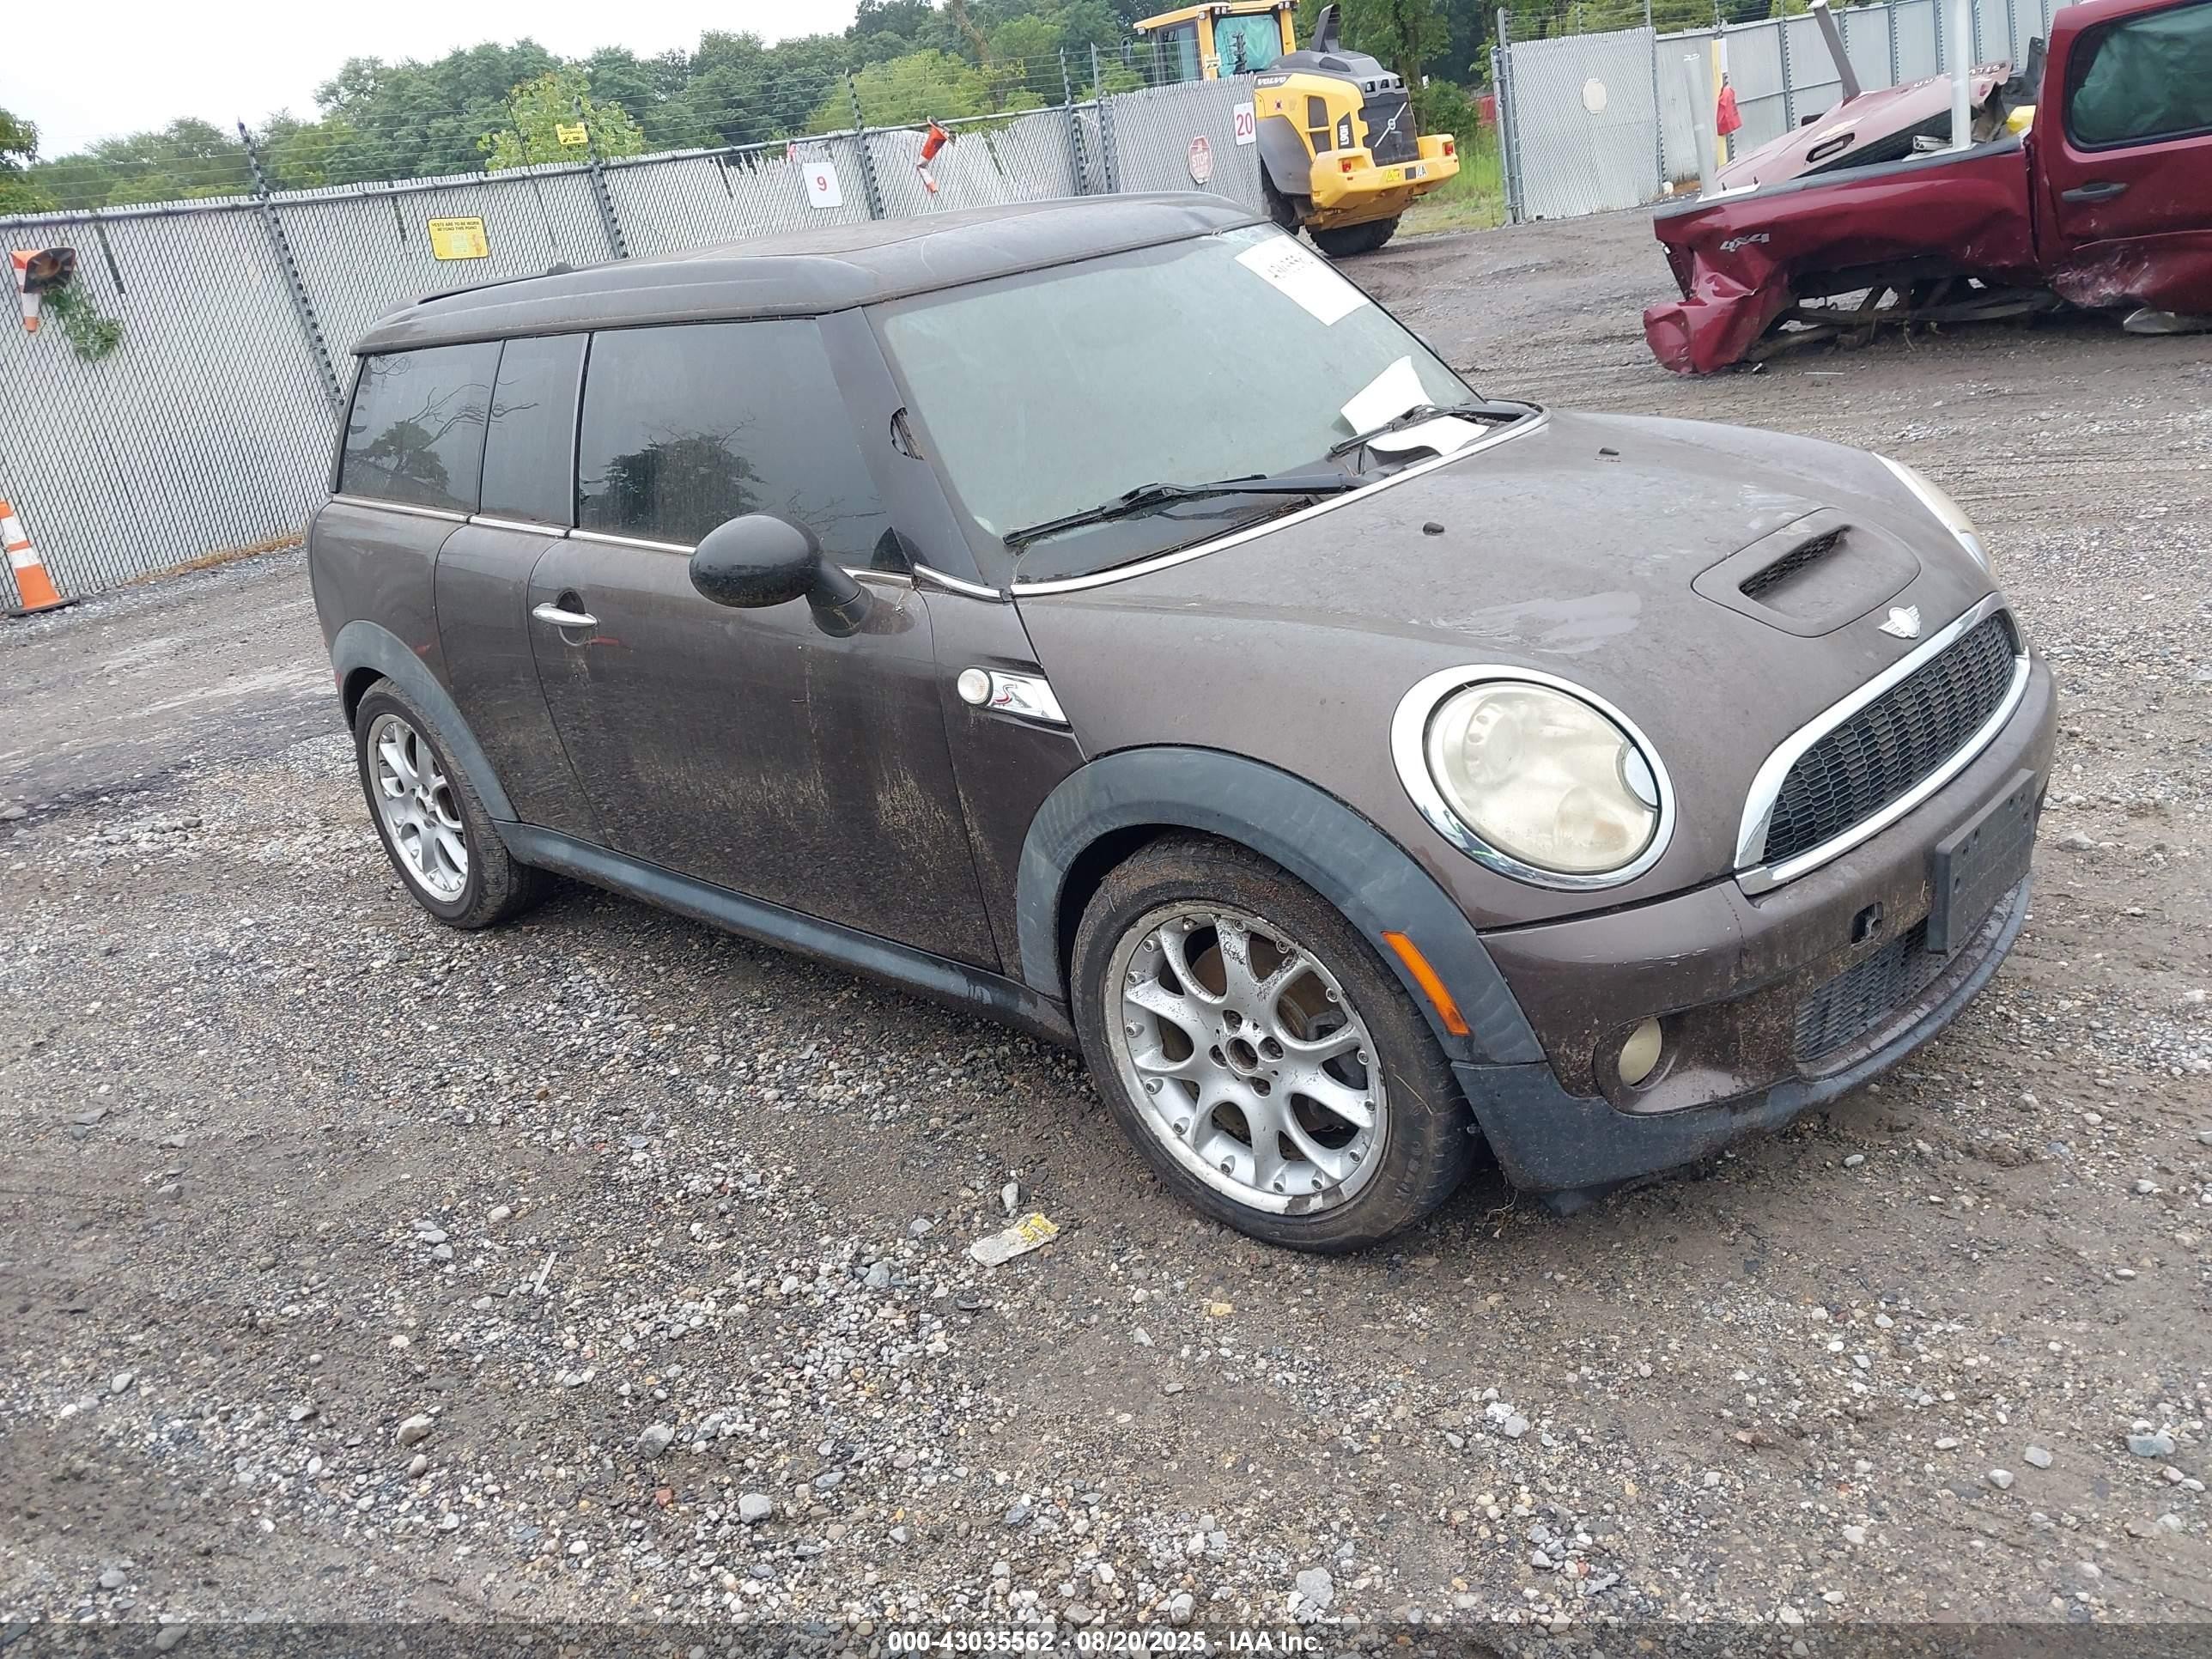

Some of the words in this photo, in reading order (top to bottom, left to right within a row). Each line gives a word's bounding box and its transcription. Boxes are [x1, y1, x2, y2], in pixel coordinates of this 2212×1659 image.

[1257, 76, 1287, 85] VOLVO
[1237, 112, 1253, 137] 20
[1340, 125, 1349, 146] L90H
[1192, 151, 1208, 167] STOP
[817, 176, 827, 191] 9
